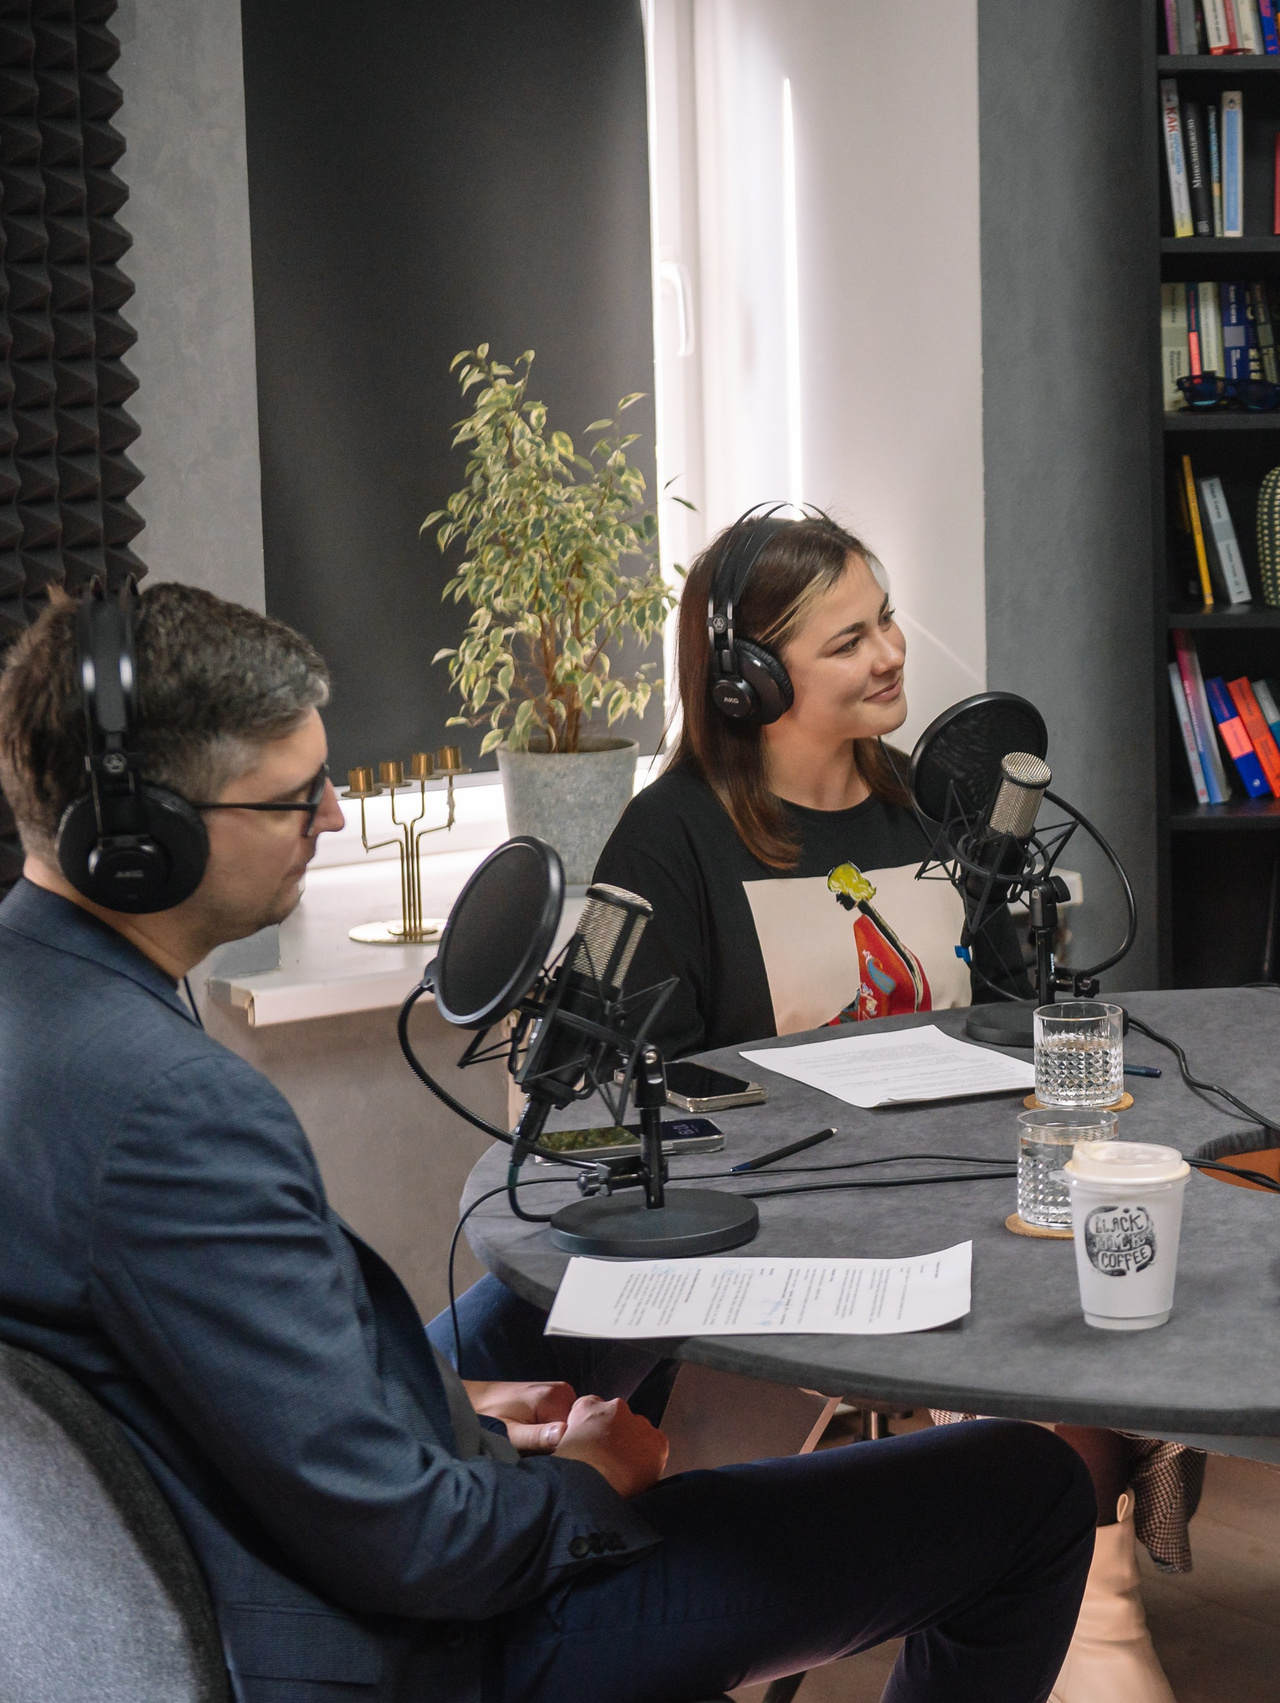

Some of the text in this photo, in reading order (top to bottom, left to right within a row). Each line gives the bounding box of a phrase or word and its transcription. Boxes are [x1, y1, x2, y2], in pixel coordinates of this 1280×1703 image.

[1165, 106, 1180, 133] КАК
[1187, 118, 1202, 189] Микеланджело
[723, 696, 739, 704] AKG
[1095, 1214, 1144, 1234] BLACK
[1100, 1247, 1150, 1271] COFFEE
